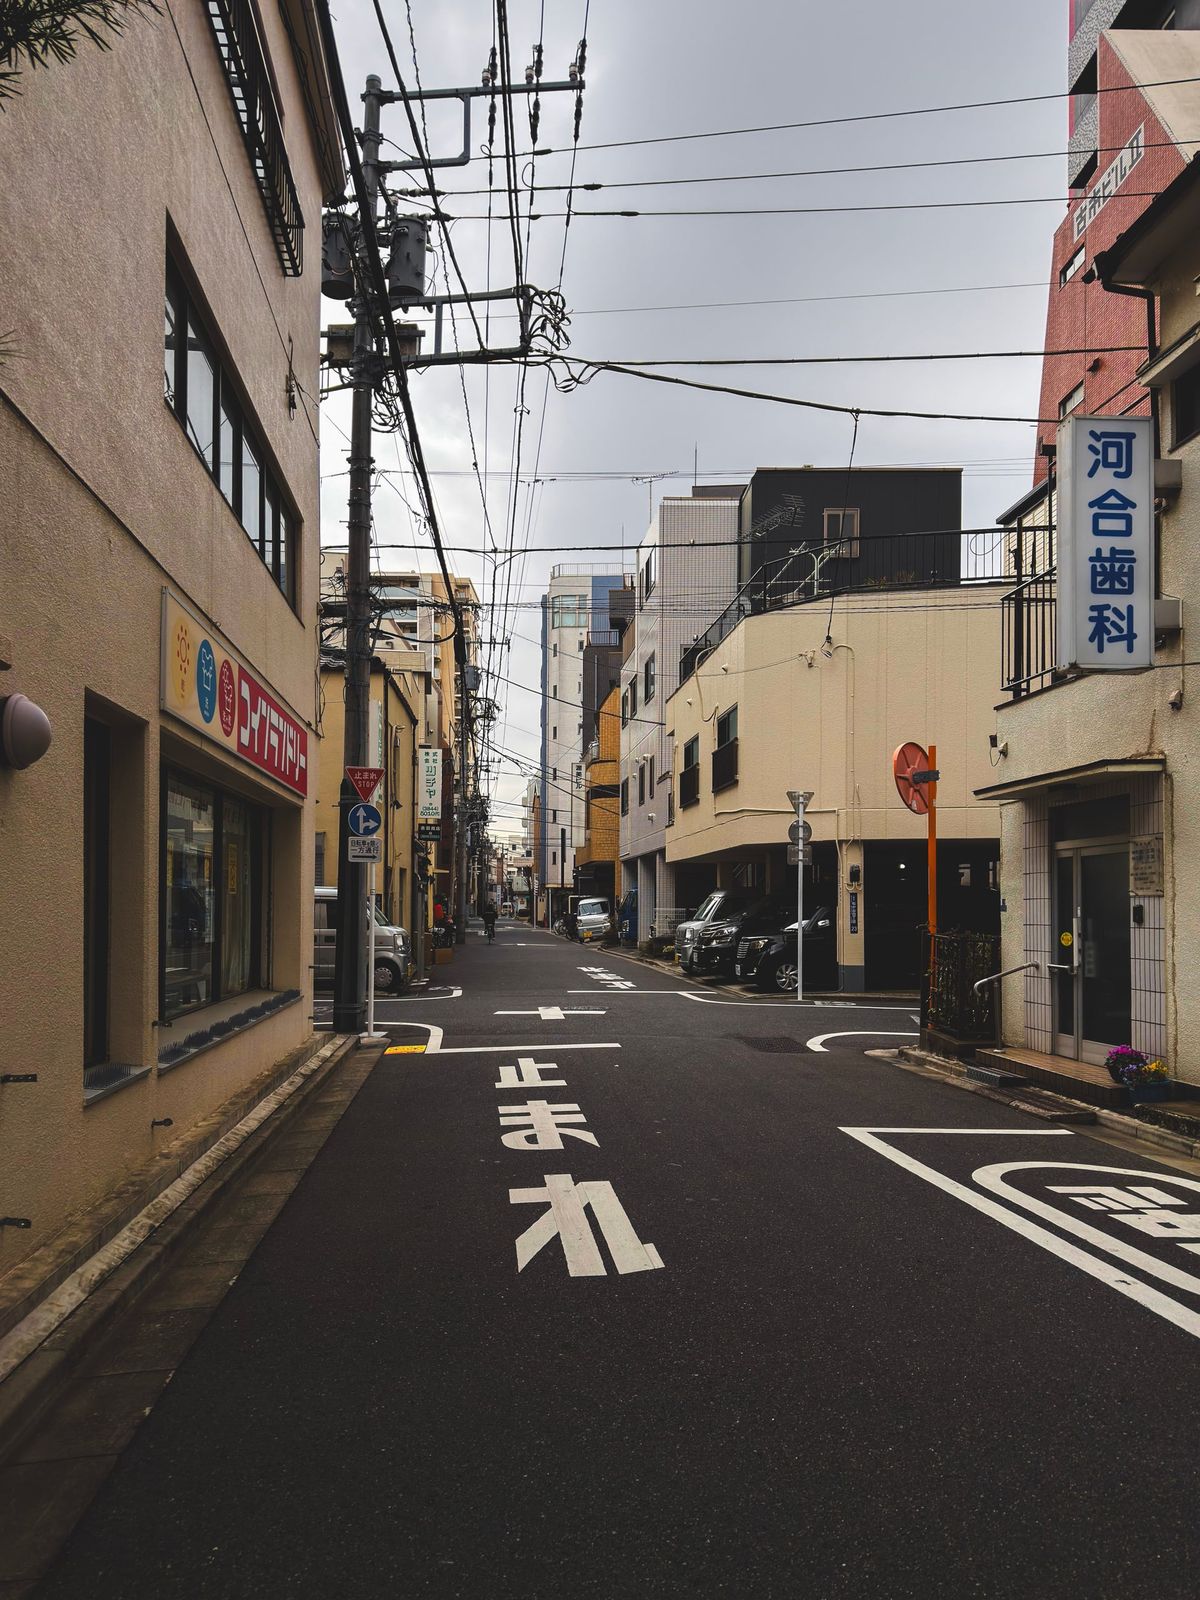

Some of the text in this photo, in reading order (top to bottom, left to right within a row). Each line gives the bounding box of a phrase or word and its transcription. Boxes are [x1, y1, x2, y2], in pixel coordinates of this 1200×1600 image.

[1088, 430, 1138, 654] 河合歯科
[240, 679, 306, 782] コインランドリー
[354, 771, 378, 780] 止まれ
[494, 1057, 666, 1277] 止まれ
